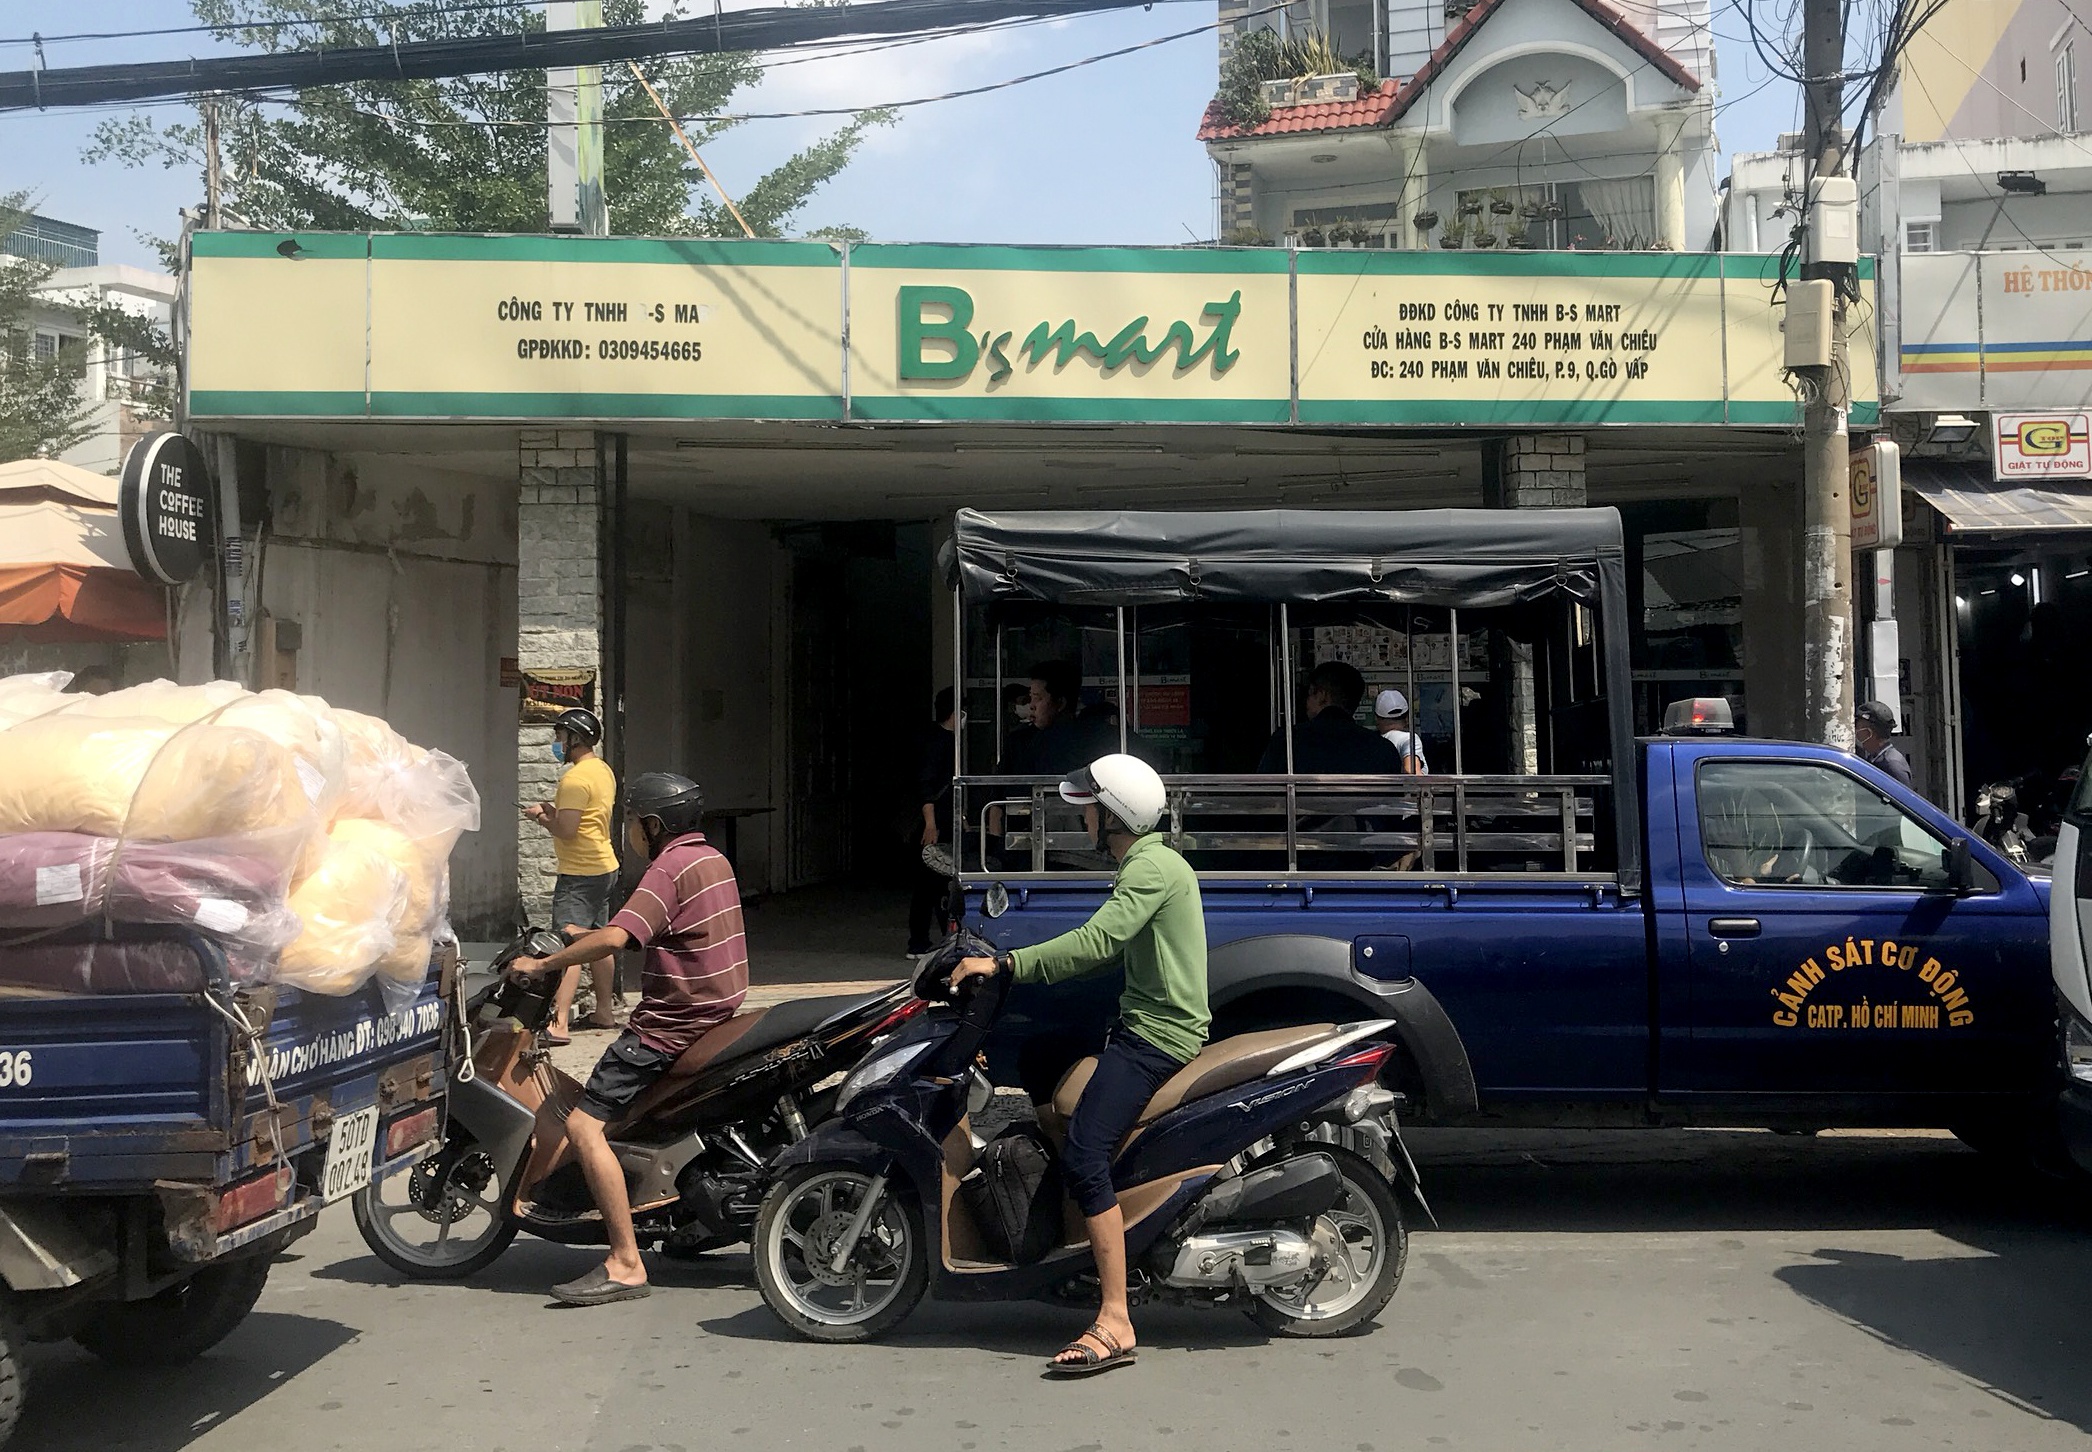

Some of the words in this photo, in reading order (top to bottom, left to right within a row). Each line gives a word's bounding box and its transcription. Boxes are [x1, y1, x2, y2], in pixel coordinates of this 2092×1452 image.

[2003, 264, 2035, 298] HỆ
[498, 296, 542, 321] CÔNG
[553, 302, 574, 321] TY
[584, 302, 628, 322] TNHH
[1444, 299, 1479, 321] CÔNG
[1487, 304, 1504, 321] TY
[1513, 304, 1548, 321] TNHH
[1556, 304, 1578, 322] B-S
[1586, 305, 1621, 322] MART
[517, 339, 591, 360] GPĐKKD:
[599, 340, 702, 361] 0309454665
[1363, 325, 1388, 350] CỬA
[1396, 327, 1431, 350] HÀNG
[1439, 332, 1461, 350] B-S
[1469, 332, 1505, 350] MART
[1512, 332, 1537, 350] 240
[1544, 332, 1581, 353] PHẠM
[1590, 329, 1613, 350] VĂN
[1371, 360, 1394, 378] ĐC:
[1399, 360, 1424, 379] 240
[1432, 361, 1468, 382] PHẠM
[1477, 358, 1500, 379] VĂN
[1625, 356, 1649, 379] VẤP
[160, 463, 182, 488] THE
[159, 489, 204, 518] COFFEE
[158, 515, 197, 541] HOUSE
[1770, 957, 1826, 1027] CẢNH
[1826, 936, 1874, 971] SÁT
[1881, 941, 1919, 971] CƠ
[1918, 956, 1974, 1027] ĐỘNG
[416, 1002, 440, 1034] 7036
[1807, 1004, 1847, 1028] CATP.
[1851, 996, 1870, 1028] HỒ
[1874, 1001, 1898, 1028] CHÍ
[1901, 1004, 1939, 1029] MINH
[0, 1050, 32, 1087] 36
